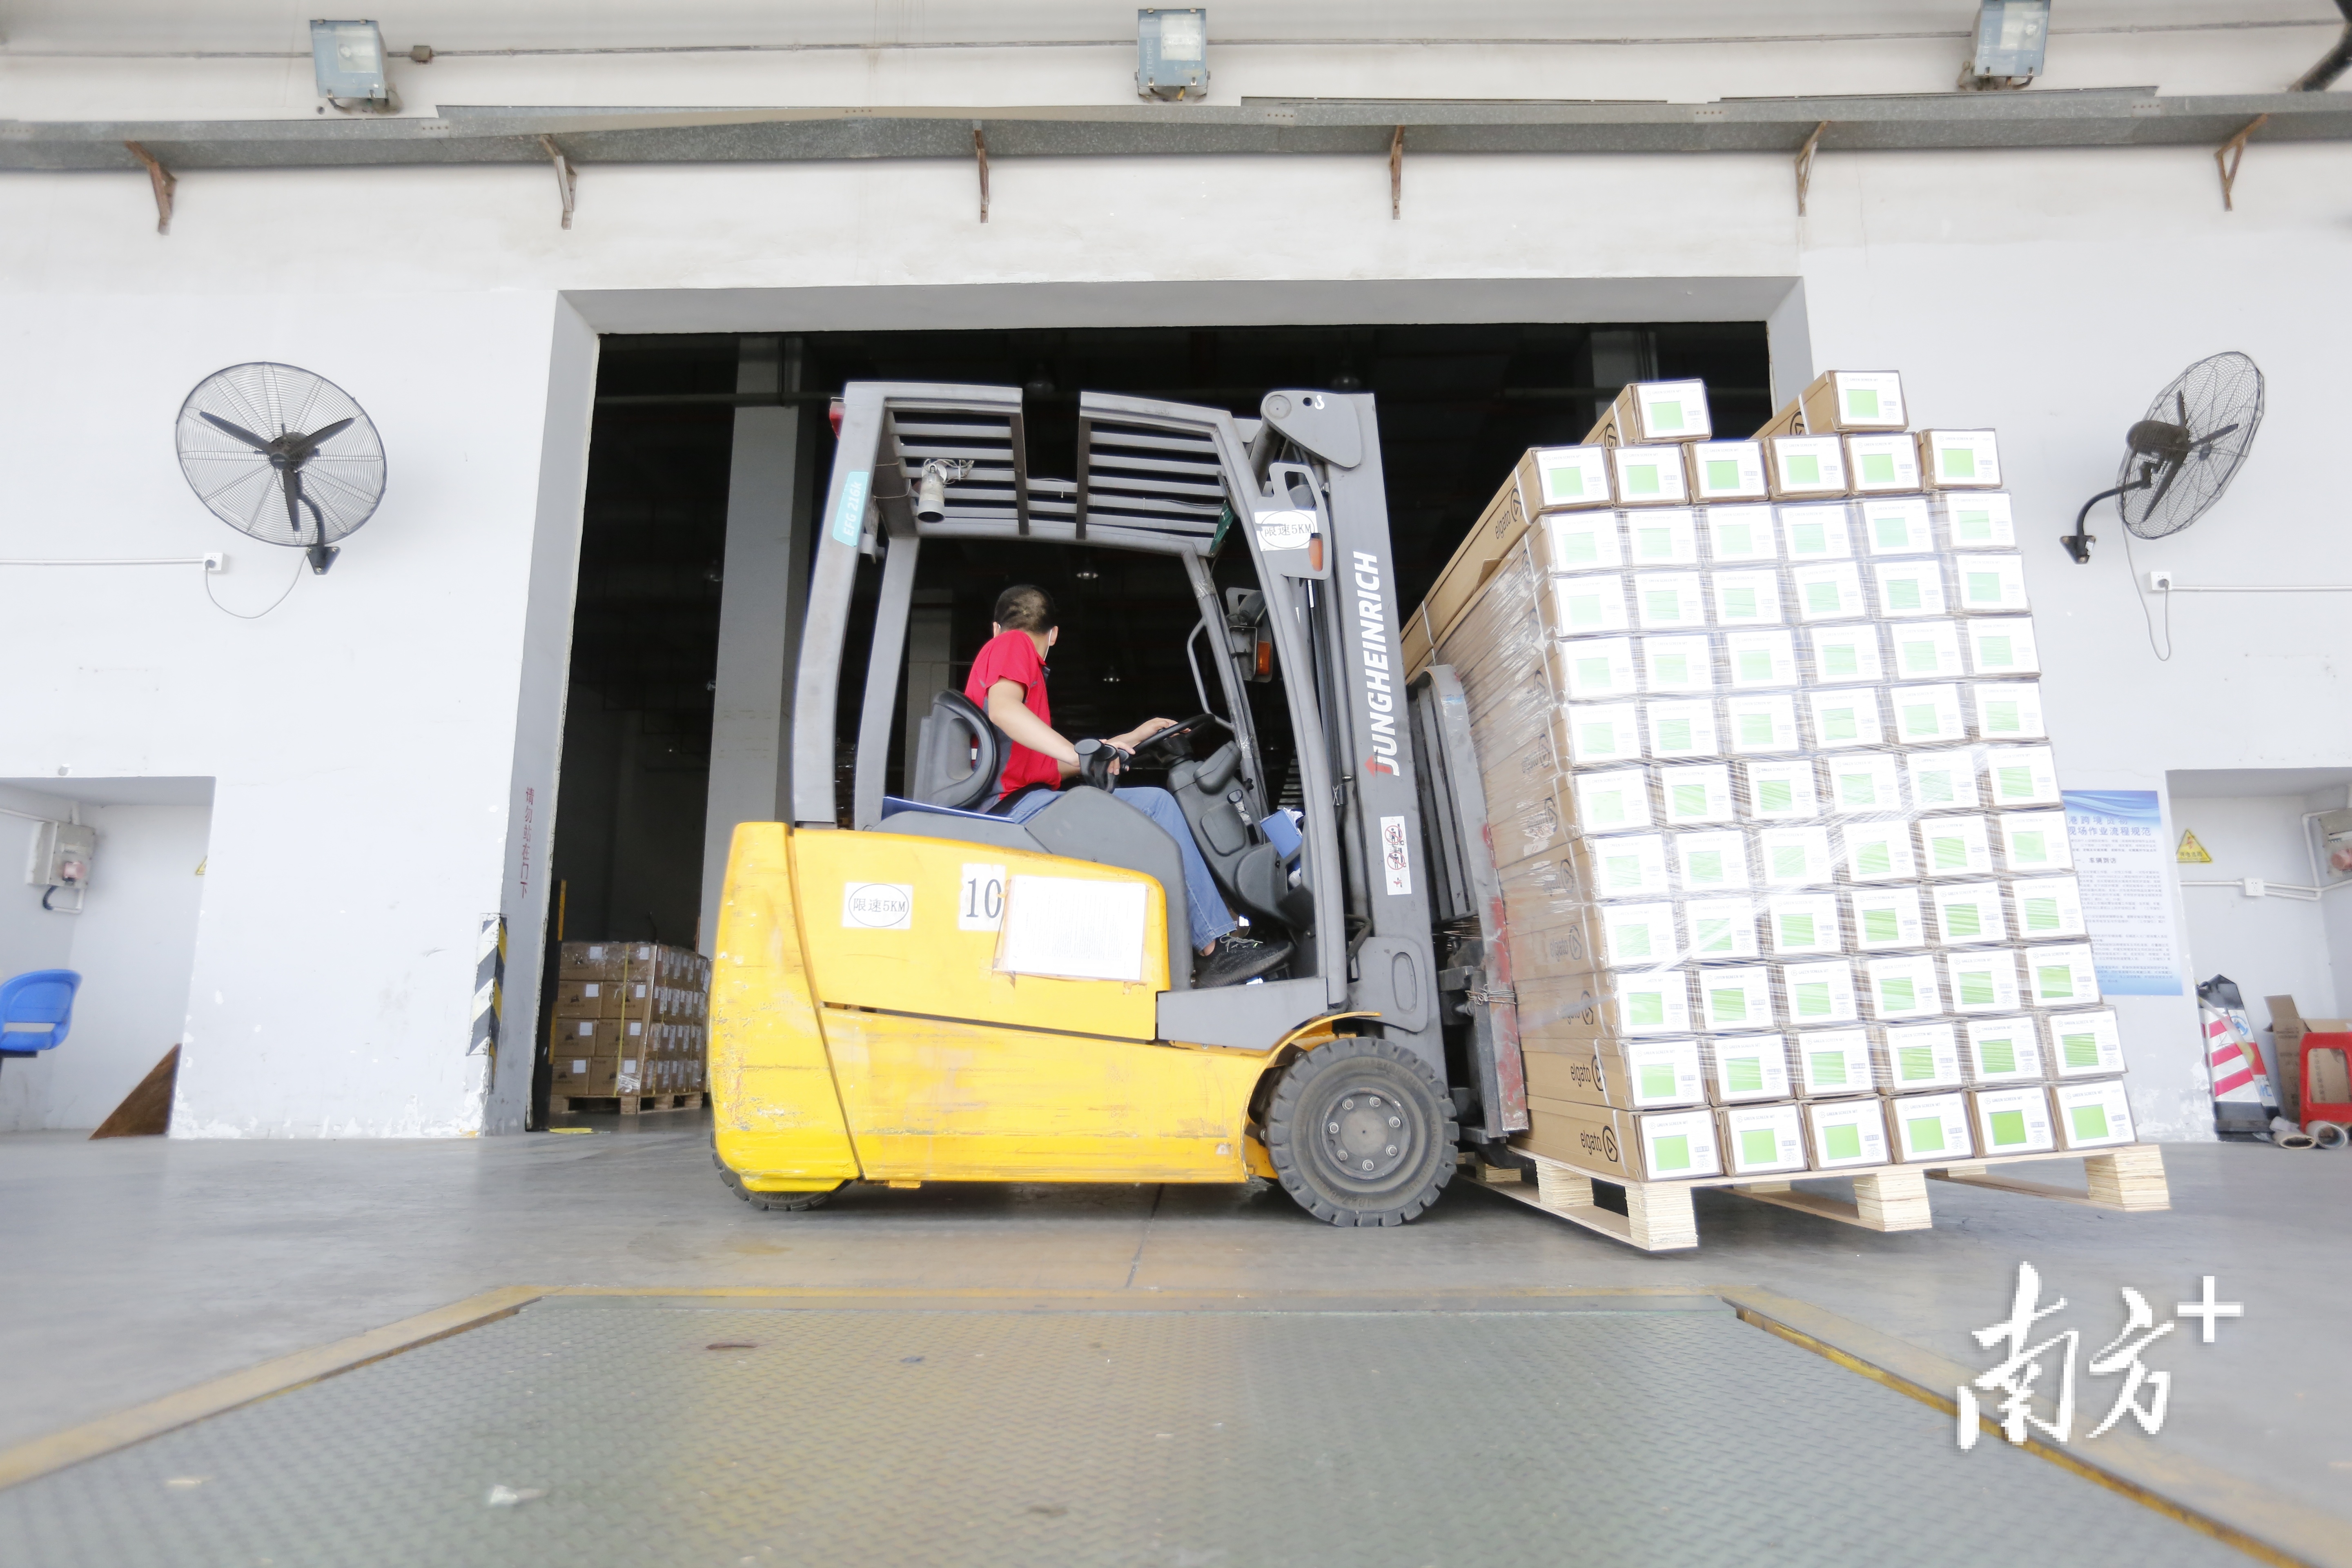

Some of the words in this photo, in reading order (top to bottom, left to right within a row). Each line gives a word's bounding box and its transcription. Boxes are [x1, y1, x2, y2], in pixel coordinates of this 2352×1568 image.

[847, 481, 862, 512] 216k
[844, 512, 856, 537] EFG
[1265, 524, 1312, 537] 限速5KM
[1495, 510, 1510, 539] elgato
[1353, 551, 1400, 777] JUNGHEINRICH
[520, 787, 535, 899] 请勿站在门下
[2068, 827, 2151, 835] 现场作业流程规范
[853, 898, 906, 913] 限速5KM
[965, 878, 1002, 918] 10
[1570, 1063, 1591, 1087] elgato
[1580, 1129, 1602, 1155] elgato
